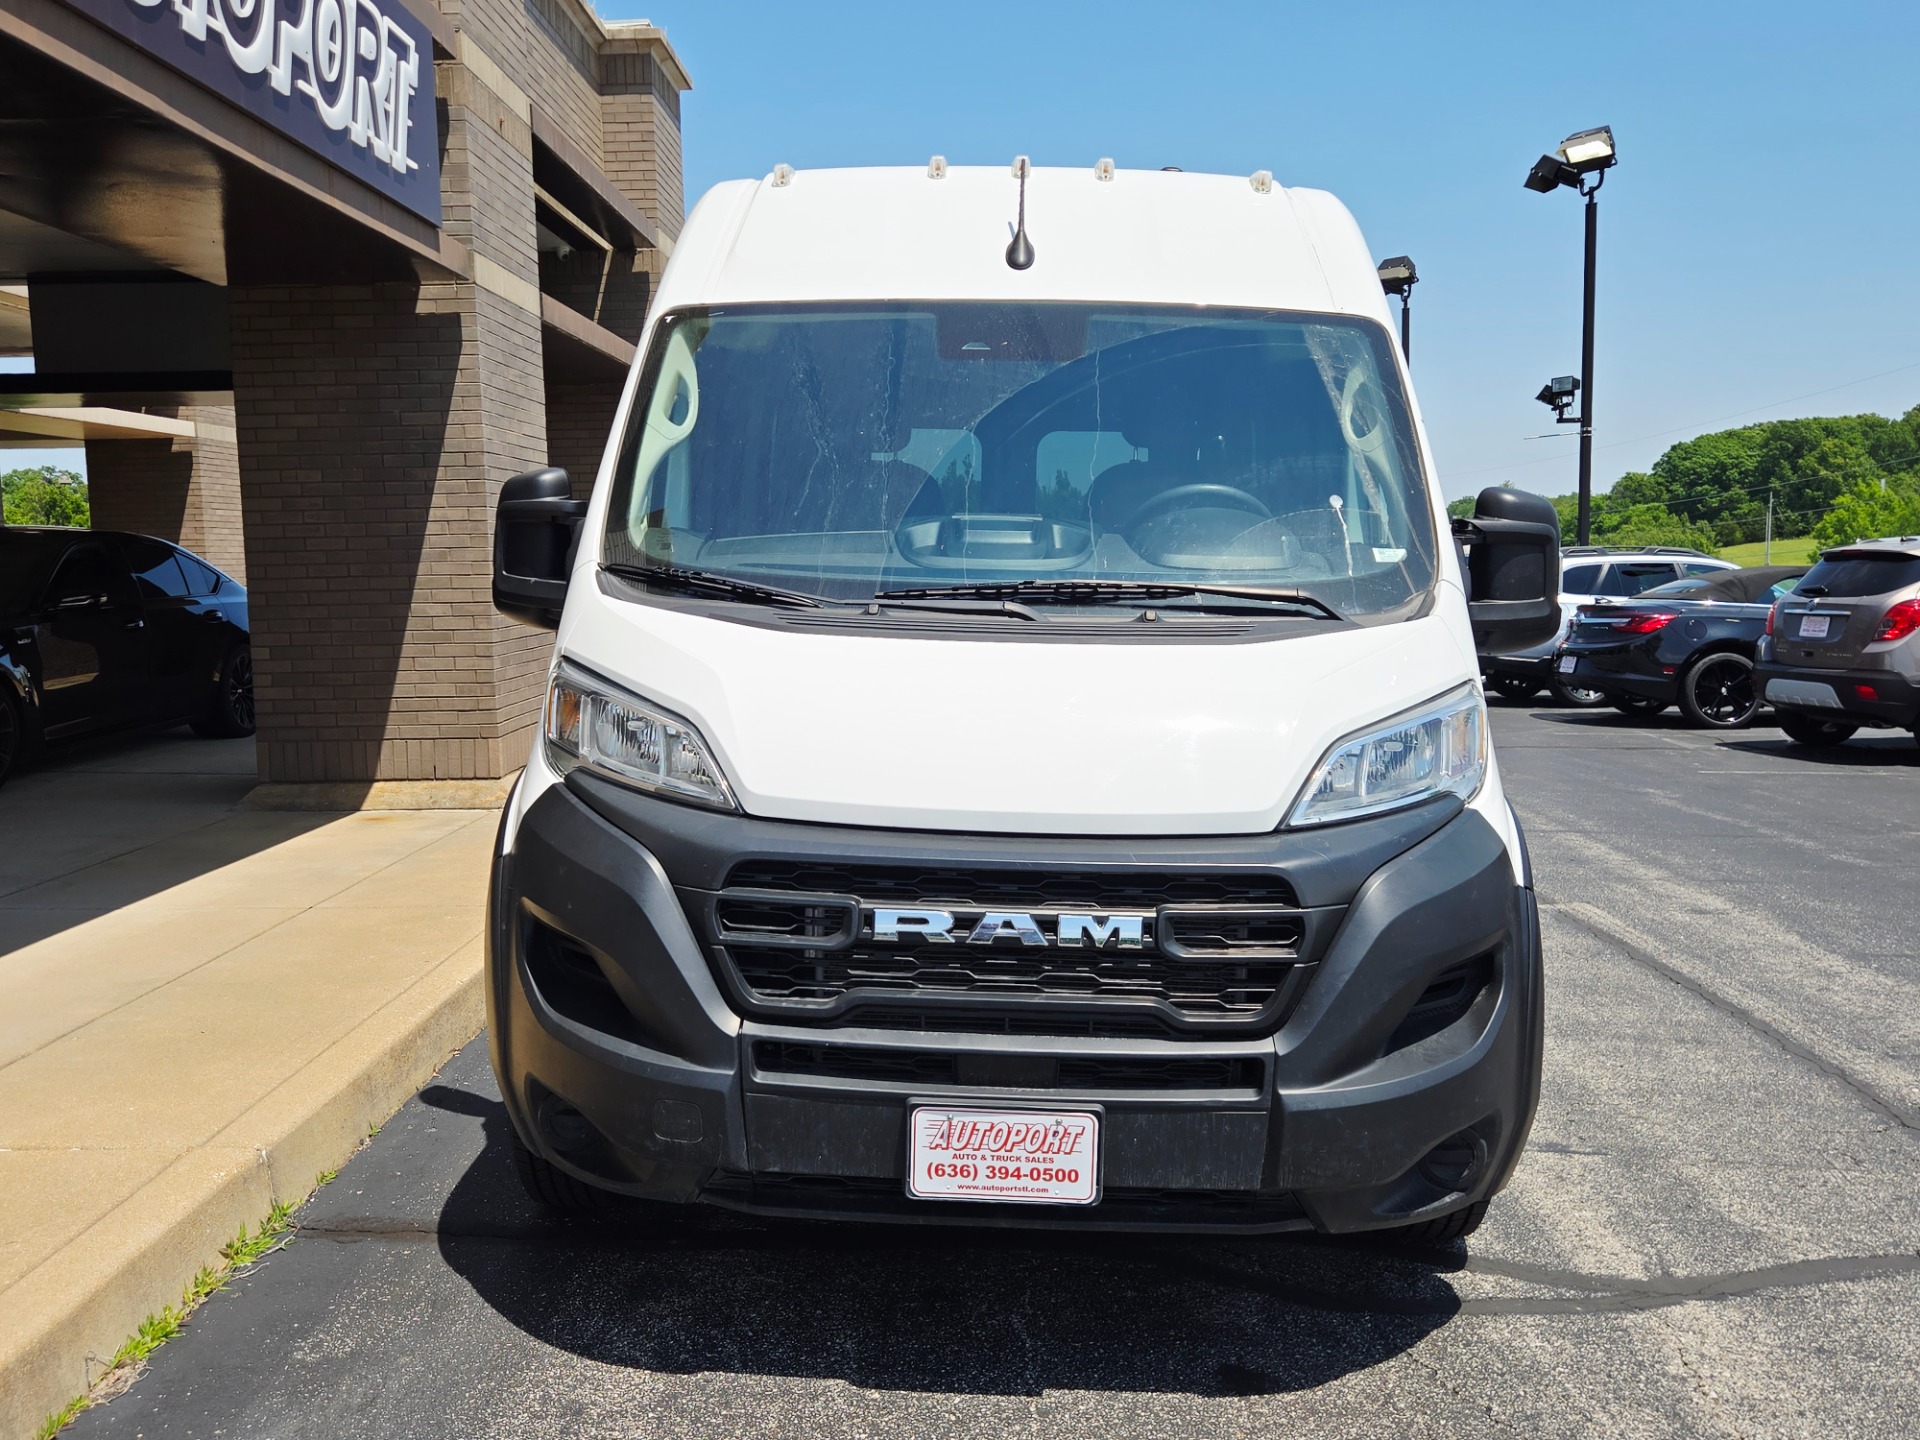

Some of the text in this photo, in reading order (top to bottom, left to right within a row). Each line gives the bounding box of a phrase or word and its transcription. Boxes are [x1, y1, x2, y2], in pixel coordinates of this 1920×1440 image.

[873, 908, 1144, 948] RAM
[927, 1119, 1086, 1155] AUTOPORT
[952, 1153, 978, 1161] AUTO
[991, 1154, 1023, 1163] TRUCK
[1025, 1156, 1055, 1164] SALES
[927, 1162, 1079, 1183] (636) 394-0500
[957, 1183, 1049, 1194] www.autoportstl.com
